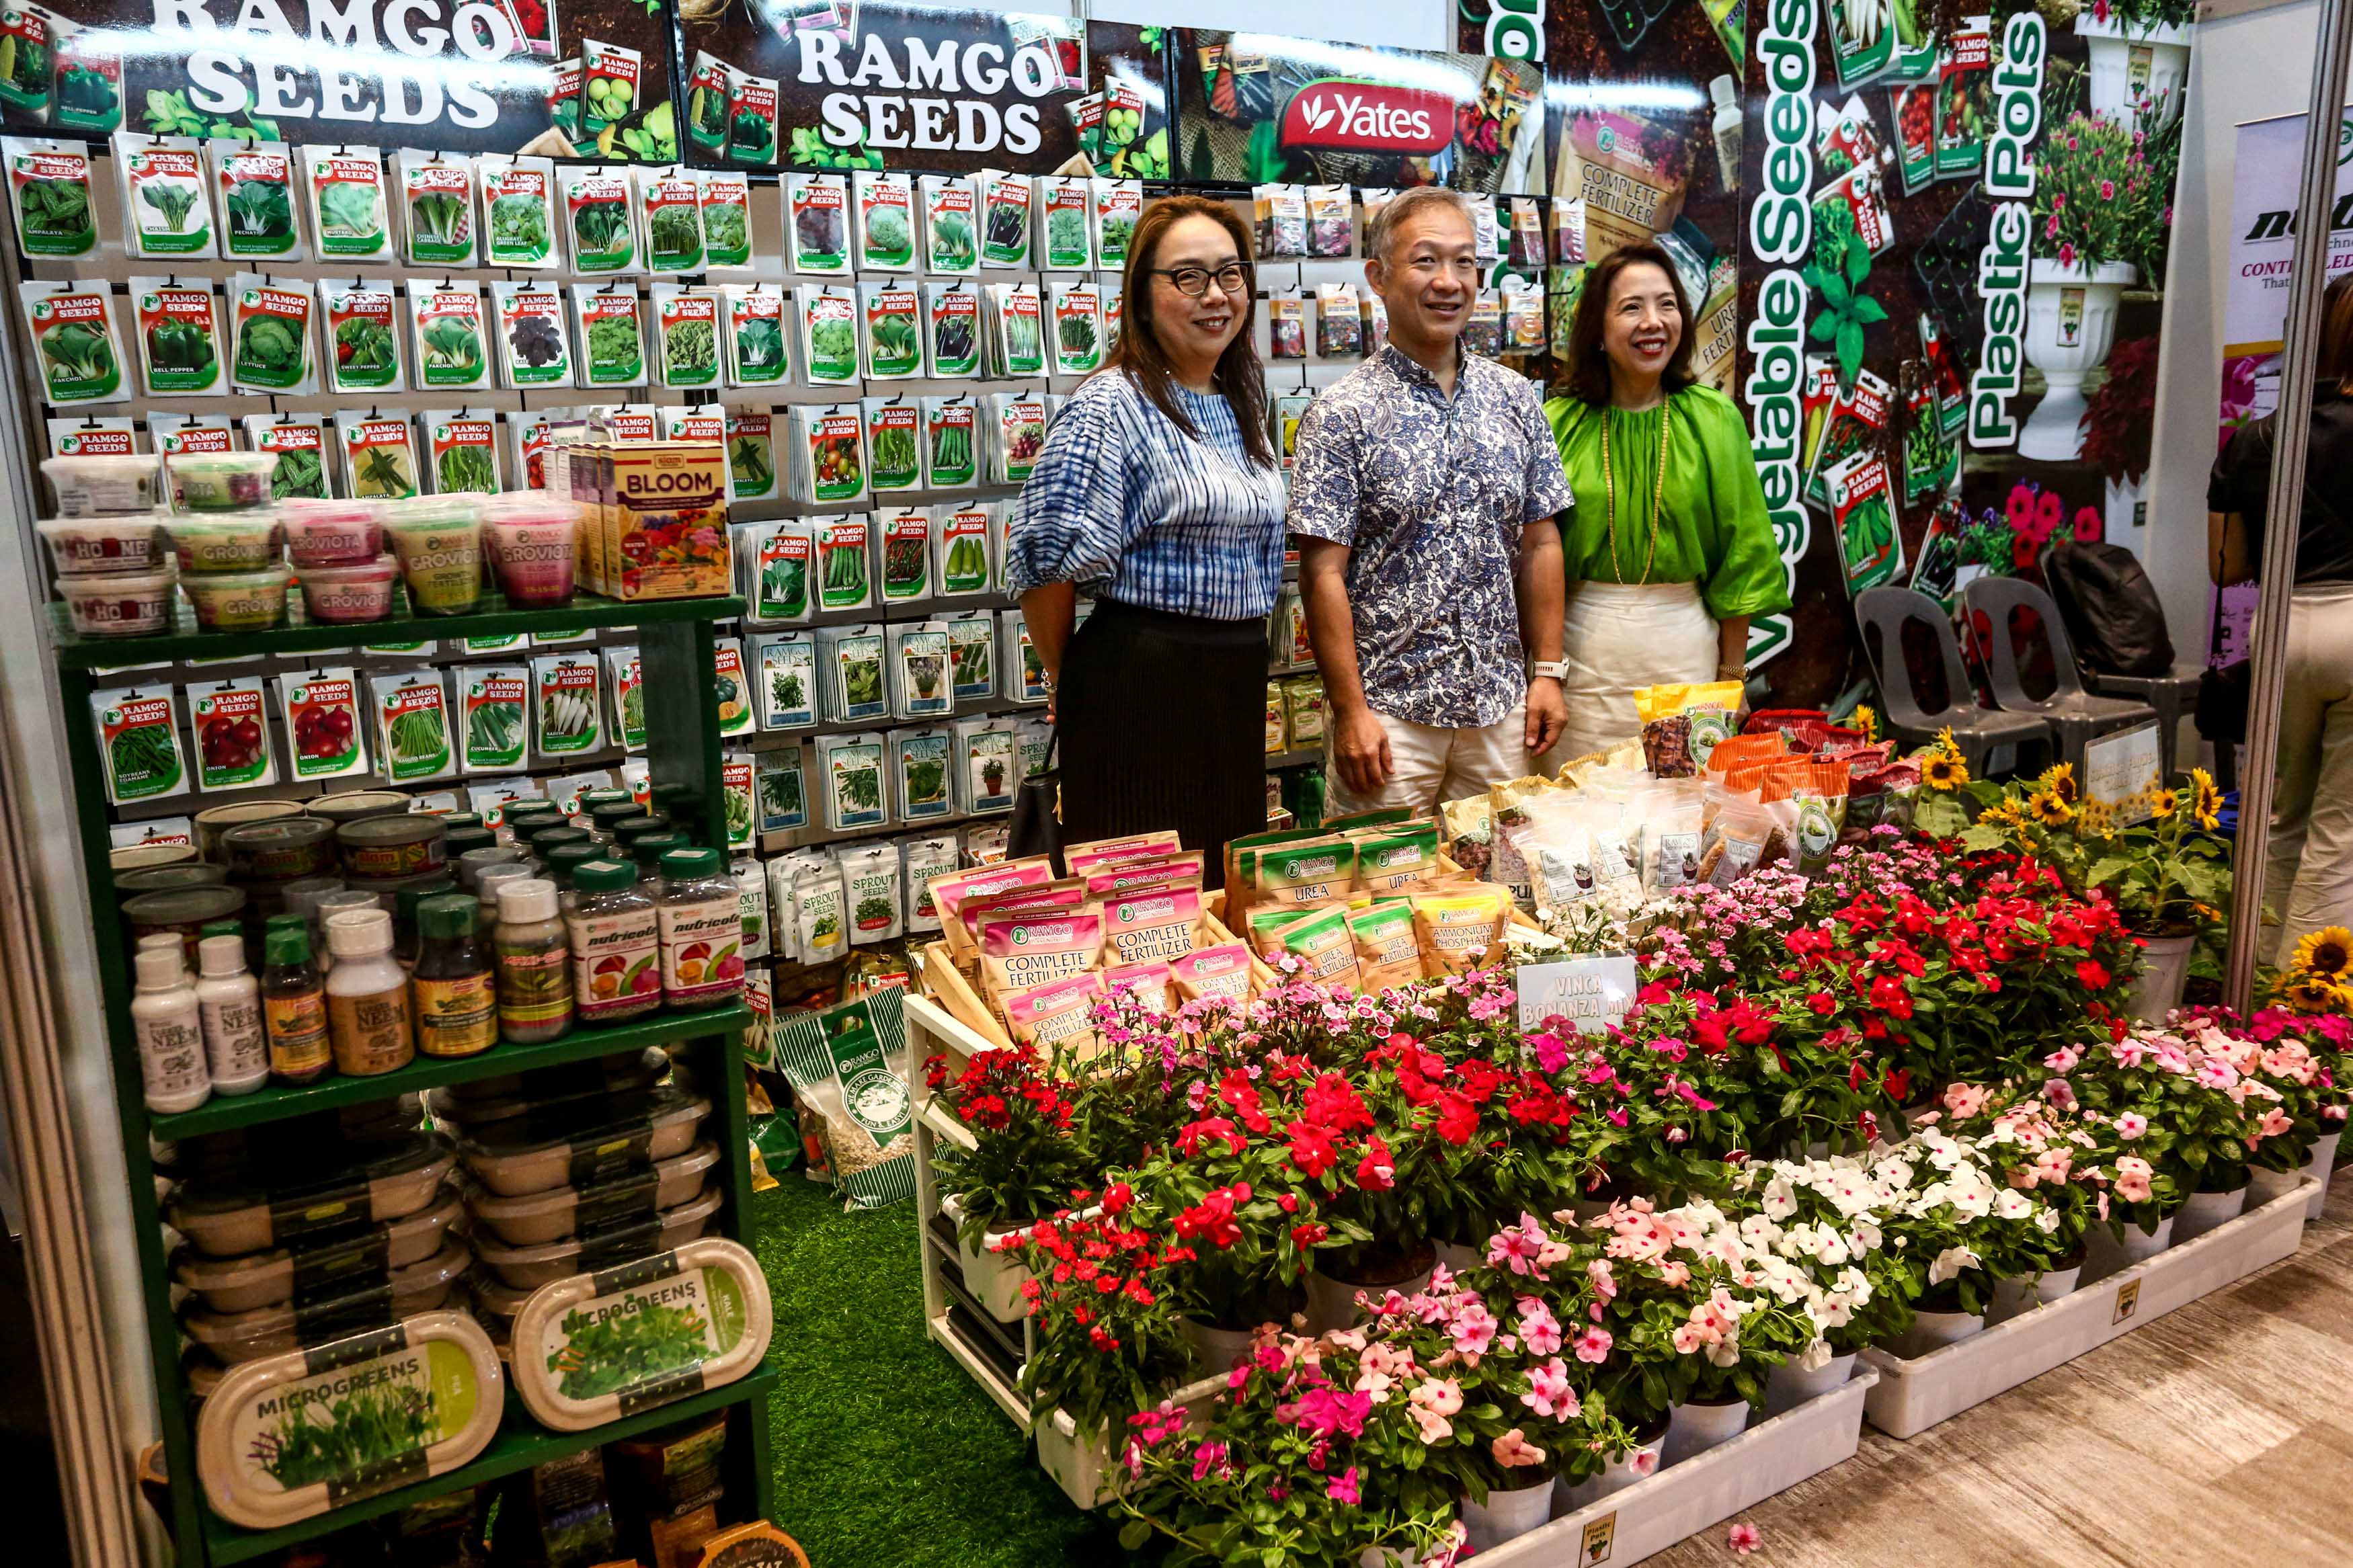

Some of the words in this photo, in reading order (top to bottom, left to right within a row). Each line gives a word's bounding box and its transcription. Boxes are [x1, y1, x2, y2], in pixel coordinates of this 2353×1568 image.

[604, 57, 637, 72] RAMGO
[795, 29, 1054, 96] RAMGO
[605, 65, 634, 77] SEEDS
[187, 50, 499, 128] SEEDS
[744, 87, 774, 98] RAMGO
[746, 96, 772, 106] SEEDS
[1991, 21, 2040, 188] Pots
[1334, 93, 1431, 139] Yates
[822, 93, 1041, 154] SEEDS
[1757, 0, 1811, 253] Seeds
[148, 154, 195, 164] RAMGO
[333, 161, 376, 172] RAMGO
[337, 171, 372, 179] SEEDS
[1582, 164, 1658, 207] COMPLETE
[808, 187, 841, 197] RAMGO
[811, 196, 840, 204] SEEDS
[1581, 183, 1653, 226] FERTILIZER
[53, 297, 101, 308] RAMGO
[162, 294, 208, 302] RAMGO
[263, 293, 307, 306] RAMGO
[518, 296, 555, 304] RAMGO
[266, 302, 303, 315] SEEDS
[354, 304, 388, 312] SEEDS
[523, 303, 555, 311] SEEDS
[885, 301, 912, 310] SEEDS
[59, 307, 100, 317] SEEDS
[1974, 212, 2026, 439] Plastic
[884, 409, 915, 418] RAMGO
[365, 424, 403, 434] RAMGO
[452, 424, 490, 433] RAMGO
[824, 419, 856, 427] RAMGO
[370, 432, 403, 441] SEEDS
[456, 433, 488, 441] SEEDS
[828, 427, 855, 435] SEEDS
[82, 434, 128, 443] RAMGO
[87, 443, 126, 452] SEEDS
[1745, 279, 1804, 665] Vgetable
[1847, 461, 1883, 491] RAMGO
[627, 472, 712, 493] BLOOM
[1852, 472, 1883, 496] SEEDS
[899, 520, 926, 528] RAMGO
[835, 526, 865, 536] RAMGO
[776, 539, 808, 548] RAMGO
[838, 534, 863, 543] SEEDS
[767, 646, 807, 656] RAMGO
[559, 669, 594, 677] RAMGO
[487, 682, 523, 690] RAMGO
[562, 676, 592, 685] SEEDS
[309, 683, 350, 694] RAMGO
[401, 687, 439, 699] RAMGO
[489, 690, 521, 698] SEEDS
[216, 693, 258, 704] RAMGO
[314, 692, 348, 701] SEEDS
[124, 702, 168, 714] RAMGO
[220, 702, 257, 712] SEEDS
[128, 711, 165, 723] SEEDS
[1300, 856, 1337, 868] RAMGO
[914, 864, 954, 879] SPROUT
[852, 874, 895, 889] SPROUT
[862, 886, 888, 897] SEEDS
[1295, 884, 1329, 901] UREA
[804, 890, 840, 909] SPROUT
[1134, 898, 1173, 911] RAMGO
[814, 903, 836, 915] SEEDS
[1028, 923, 1072, 937] RAMGO
[1117, 923, 1189, 948] COMPLETE
[1433, 925, 1493, 938] AMMONIUM
[1386, 938, 1407, 950] UREA
[1435, 936, 1491, 947] PHOSPHATE
[1120, 941, 1193, 962] FERTILIZER
[1320, 948, 1343, 963] UREA
[1379, 946, 1417, 962] FERTILIZER
[1006, 952, 1086, 972] COMPLETE
[1313, 954, 1354, 979] FERTILIZER
[1555, 975, 1603, 995] VINCA
[1522, 999, 1600, 1025] BONANZA
[850, 1048, 879, 1065] RAMGO
[850, 1077, 867, 1095] MAKE
[848, 1096, 854, 1104] WE
[861, 1118, 876, 1127] FUN
[887, 1112, 905, 1127] EASY!
[257, 1358, 420, 1418] MICROGREENS
